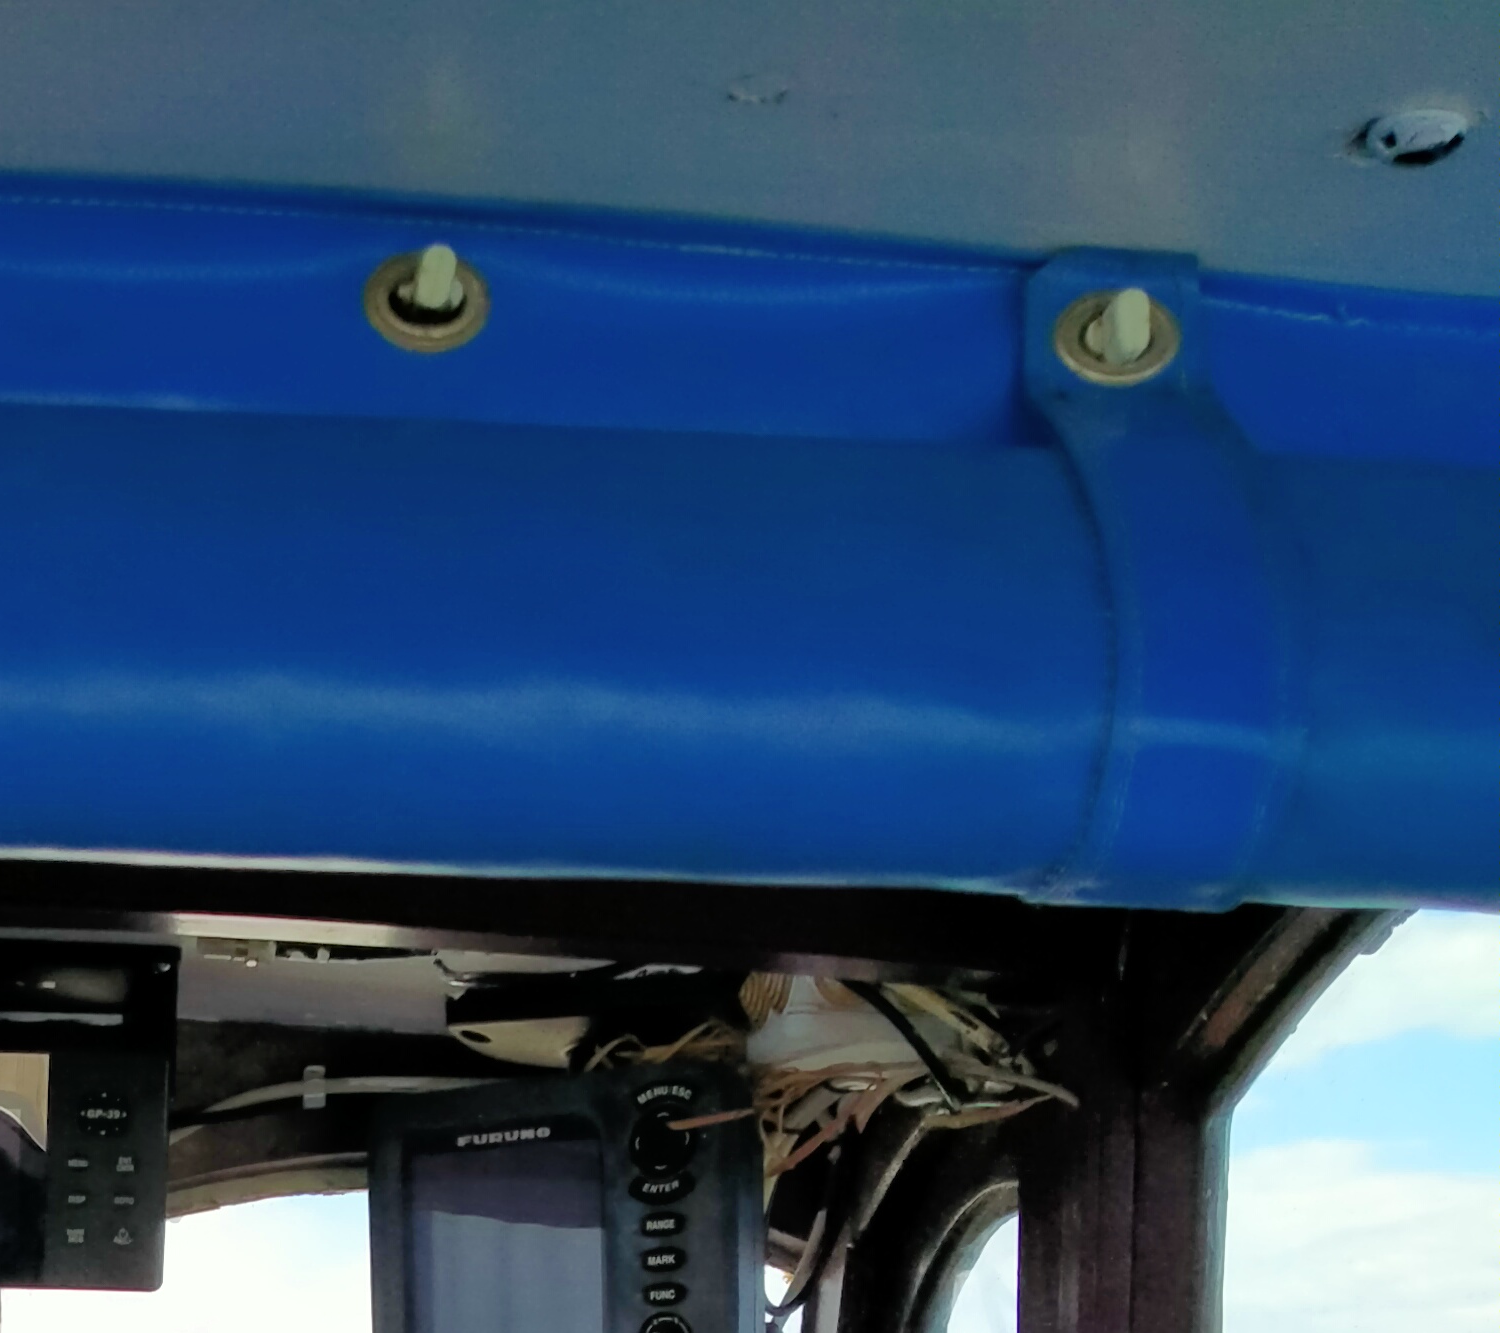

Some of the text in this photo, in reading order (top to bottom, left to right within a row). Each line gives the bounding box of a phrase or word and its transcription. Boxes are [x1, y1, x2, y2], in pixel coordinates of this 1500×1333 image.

[456, 1126, 551, 1147] FURUNO
[642, 1180, 680, 1194] ENTER
[645, 1218, 676, 1231] RANGE
[647, 1254, 676, 1267] MARK
[649, 1289, 676, 1301] FUNC
